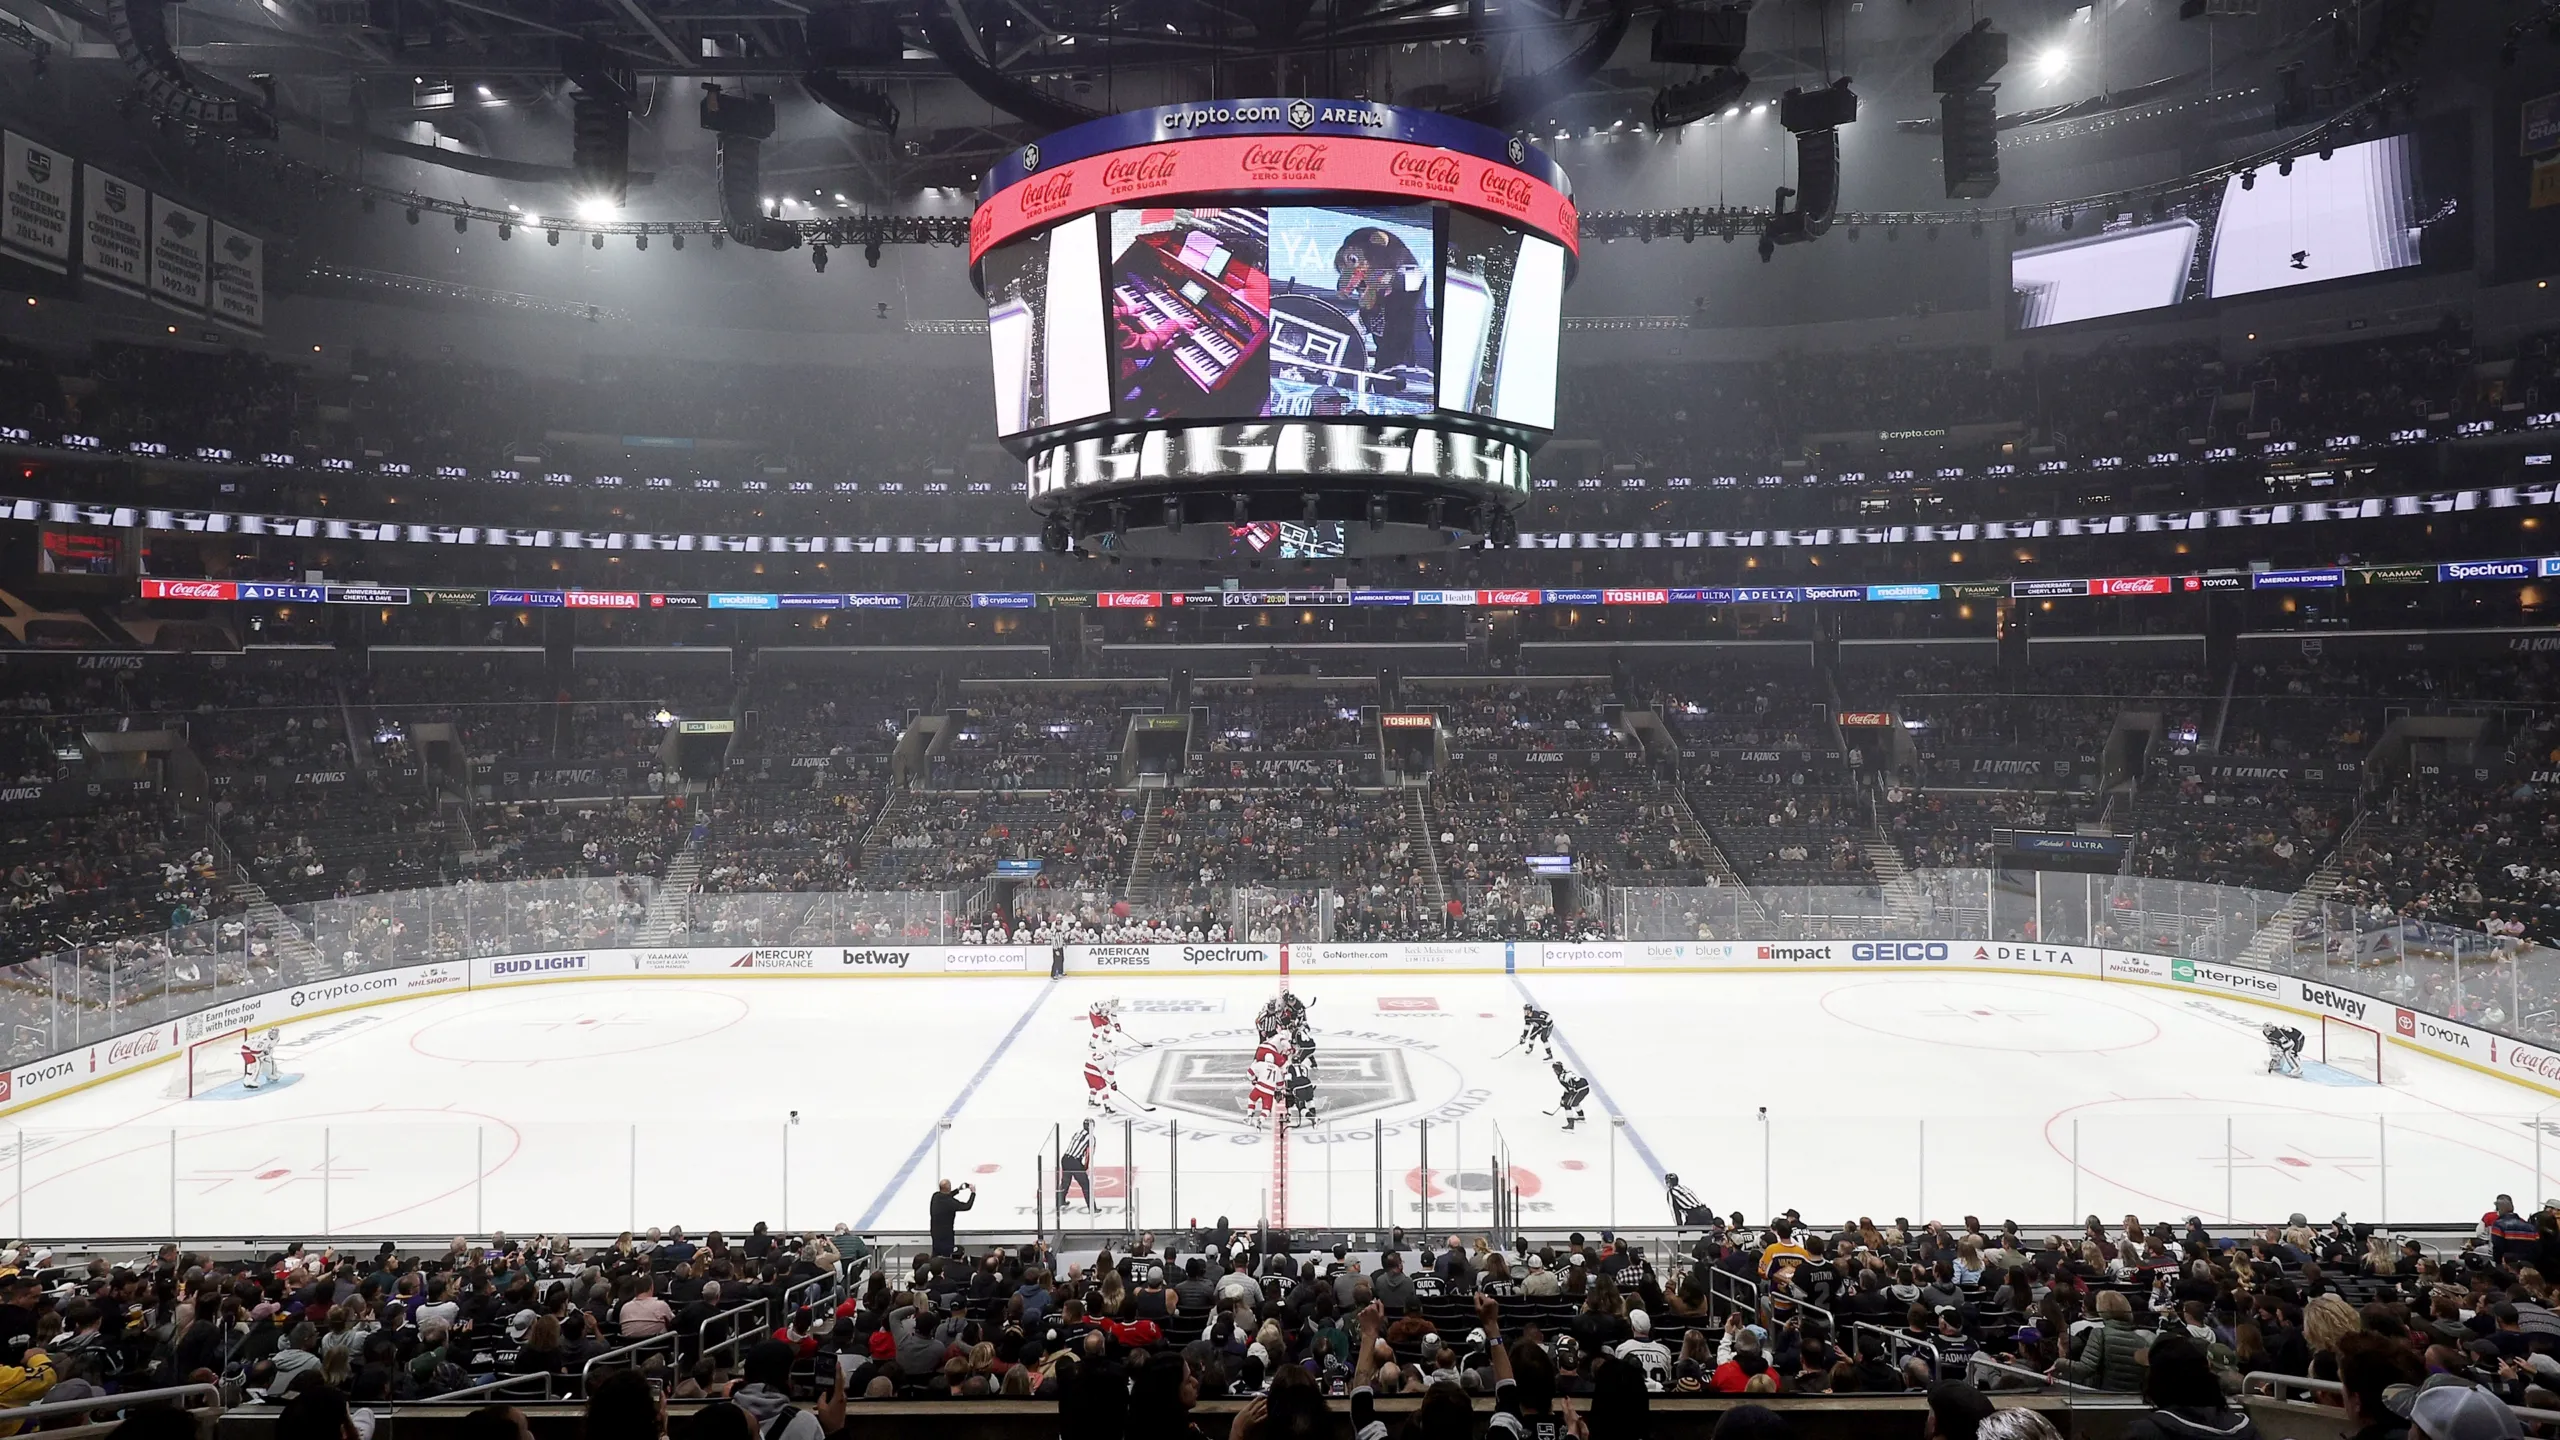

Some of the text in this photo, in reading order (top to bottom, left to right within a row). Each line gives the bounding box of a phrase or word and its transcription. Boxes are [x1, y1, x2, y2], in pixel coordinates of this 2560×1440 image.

[1164, 106, 1384, 130] crypto.com ARENA
[1242, 144, 1329, 171] Coca-Cola
[1103, 150, 1180, 187] Coca-Cola
[1390, 150, 1460, 185] Coca-Cola
[1021, 170, 1075, 212] Coca-Cola
[1111, 180, 1167, 195] ZERO SUGAR
[1399, 179, 1454, 193] ZERO SUGAR
[1480, 168, 1533, 206] Coca-Cola
[1026, 200, 1066, 219] ZERO SUGAR
[1487, 195, 1527, 213] ZERO SUGAR
[1890, 428, 1944, 440] crypto.com
[2449, 562, 2522, 577] Spectrum
[2202, 579, 2238, 587] TOYOTA
[2259, 572, 2338, 583] AMERICAN EXPRESS
[169, 583, 221, 597] Coca-Cola
[1877, 587, 1928, 596] mobilitie
[2111, 580, 2154, 592] Coca-Cola
[264, 588, 319, 599] DELTA
[530, 594, 562, 603] ULTRA
[1116, 594, 1150, 605] Coca-Cola
[1444, 593, 1473, 603] Health
[1495, 591, 1528, 602] Coca-Cola
[1558, 593, 1596, 601] crypto.com
[1607, 592, 1664, 602] TOSHIBA
[1702, 592, 1730, 600] ULTRA
[1752, 590, 1794, 599] DELTA
[1805, 588, 1856, 600] Spectrum
[569, 594, 635, 606] TOSHIBA
[719, 596, 768, 605] mobilitie
[850, 596, 898, 607] Spectrum
[990, 597, 1028, 605] crypto.com
[1384, 717, 1431, 726] TOSHIBA
[805, 757, 830, 766] KINGS
[1526, 752, 1564, 762] LA KINGS
[1741, 751, 1780, 761] LA KINGS
[404, 768, 418, 776] 117
[1972, 760, 2040, 774] LA KINGS
[2337, 763, 2355, 771] 105
[215, 777, 231, 785] 117
[312, 772, 346, 785] KINGS
[2531, 771, 2549, 782] LA
[1, 787, 42, 802] KINGS
[2072, 841, 2103, 849] ULTRA
[755, 950, 812, 959] MERCURY
[1089, 947, 1149, 956] AMERICAN
[1183, 947, 1262, 964] Spectrum
[1322, 950, 1387, 960] GoNorther.com
[1556, 949, 1622, 960] crypto.com
[1647, 945, 1672, 956] blue
[1695, 945, 1720, 956] blue
[1771, 945, 1830, 961] impact
[1852, 943, 1948, 960] GEICO
[1998, 947, 2073, 964] DELTA
[755, 960, 813, 968] INSURANCE
[843, 949, 910, 968] betway
[957, 953, 1023, 965] crypto.com
[1097, 957, 1150, 966] EXPRESS
[494, 956, 585, 974] BUD LIGHT
[2180, 965, 2278, 991] enterprise
[308, 975, 398, 1001] crypto.com
[2302, 983, 2366, 1020] betway
[206, 1000, 261, 1022] Earn free food
[206, 1014, 255, 1033] with the app
[2420, 1022, 2469, 1049] TOYOTA
[108, 1030, 160, 1064] Coca-Cola
[17, 1062, 74, 1088] TOYOTA
[1266, 1069, 1278, 1082] 71
[1417, 1280, 1436, 1288] QUICK
[1814, 1281, 1829, 1307] 2
[1640, 1353, 1661, 1363] TOLL
